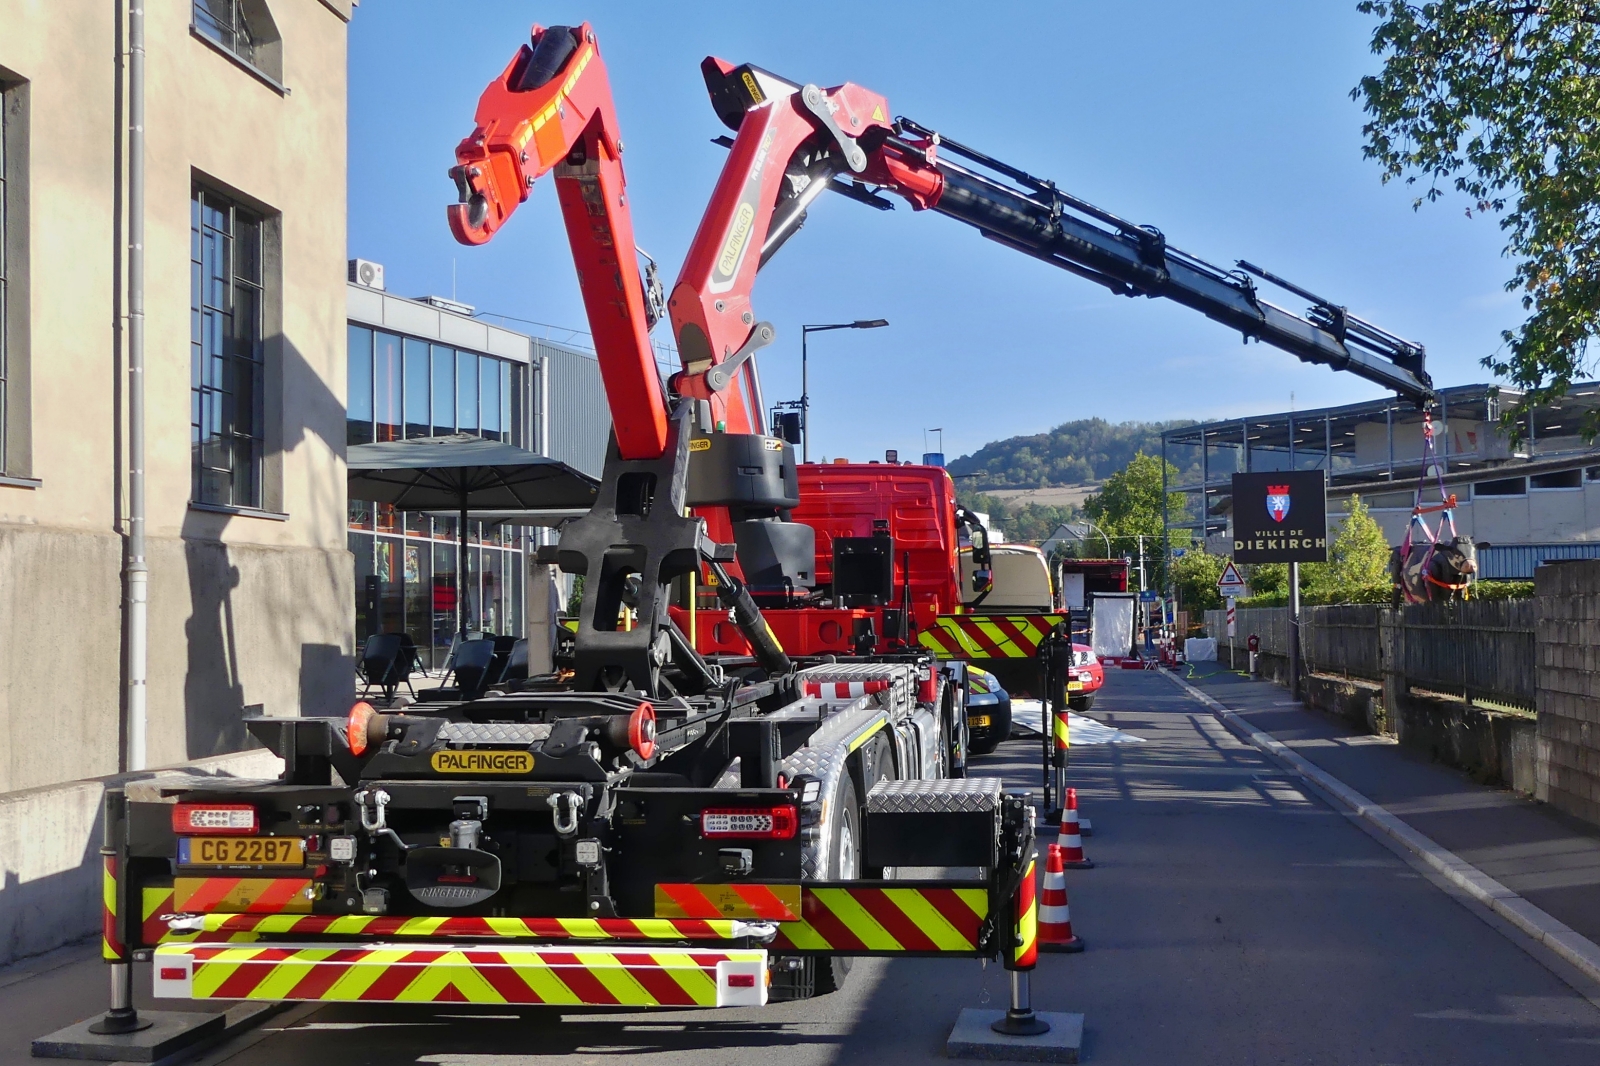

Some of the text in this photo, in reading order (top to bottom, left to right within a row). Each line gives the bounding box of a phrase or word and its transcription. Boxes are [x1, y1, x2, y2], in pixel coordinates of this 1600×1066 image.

[721, 207, 752, 271] PALFINGER
[1234, 539, 1325, 550] DIEKIRCH
[971, 716, 986, 725] 1351
[438, 754, 528, 770] PALFINGER
[182, 852, 188, 861] L
[201, 840, 292, 862] CG 2287
[420, 886, 480, 899] RINGFEDER
